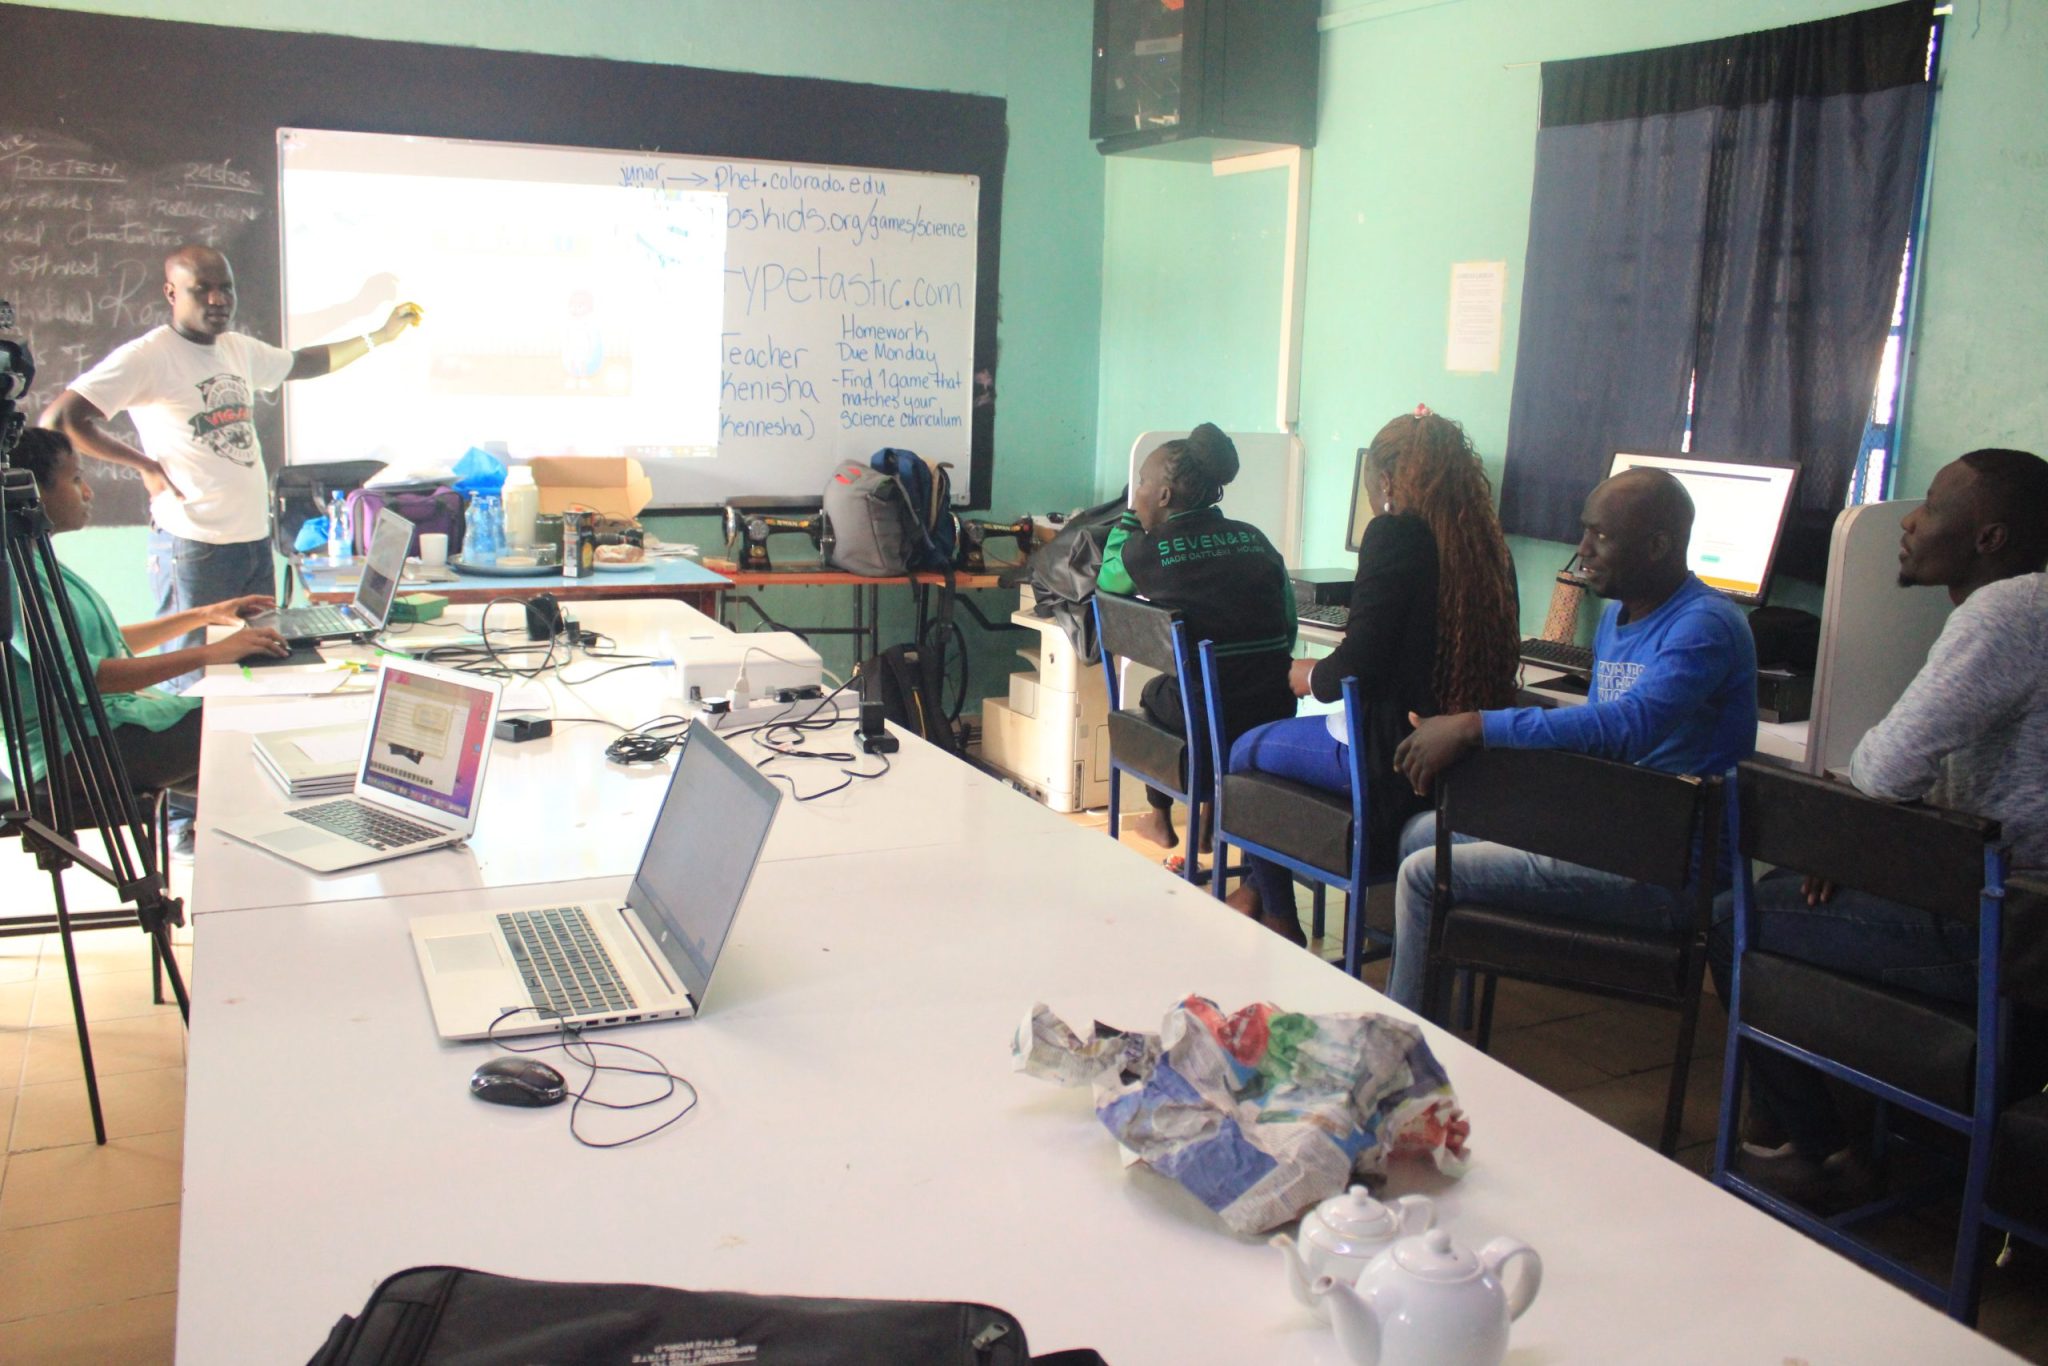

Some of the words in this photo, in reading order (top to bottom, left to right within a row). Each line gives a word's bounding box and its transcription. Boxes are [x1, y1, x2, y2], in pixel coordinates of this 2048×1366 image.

[842, 313, 929, 343] Homework
[721, 333, 809, 369] Teacher
[836, 342, 869, 362] Due
[874, 343, 939, 374] Monday
[888, 373, 930, 397] game
[842, 390, 900, 410] matches
[903, 396, 938, 415] your
